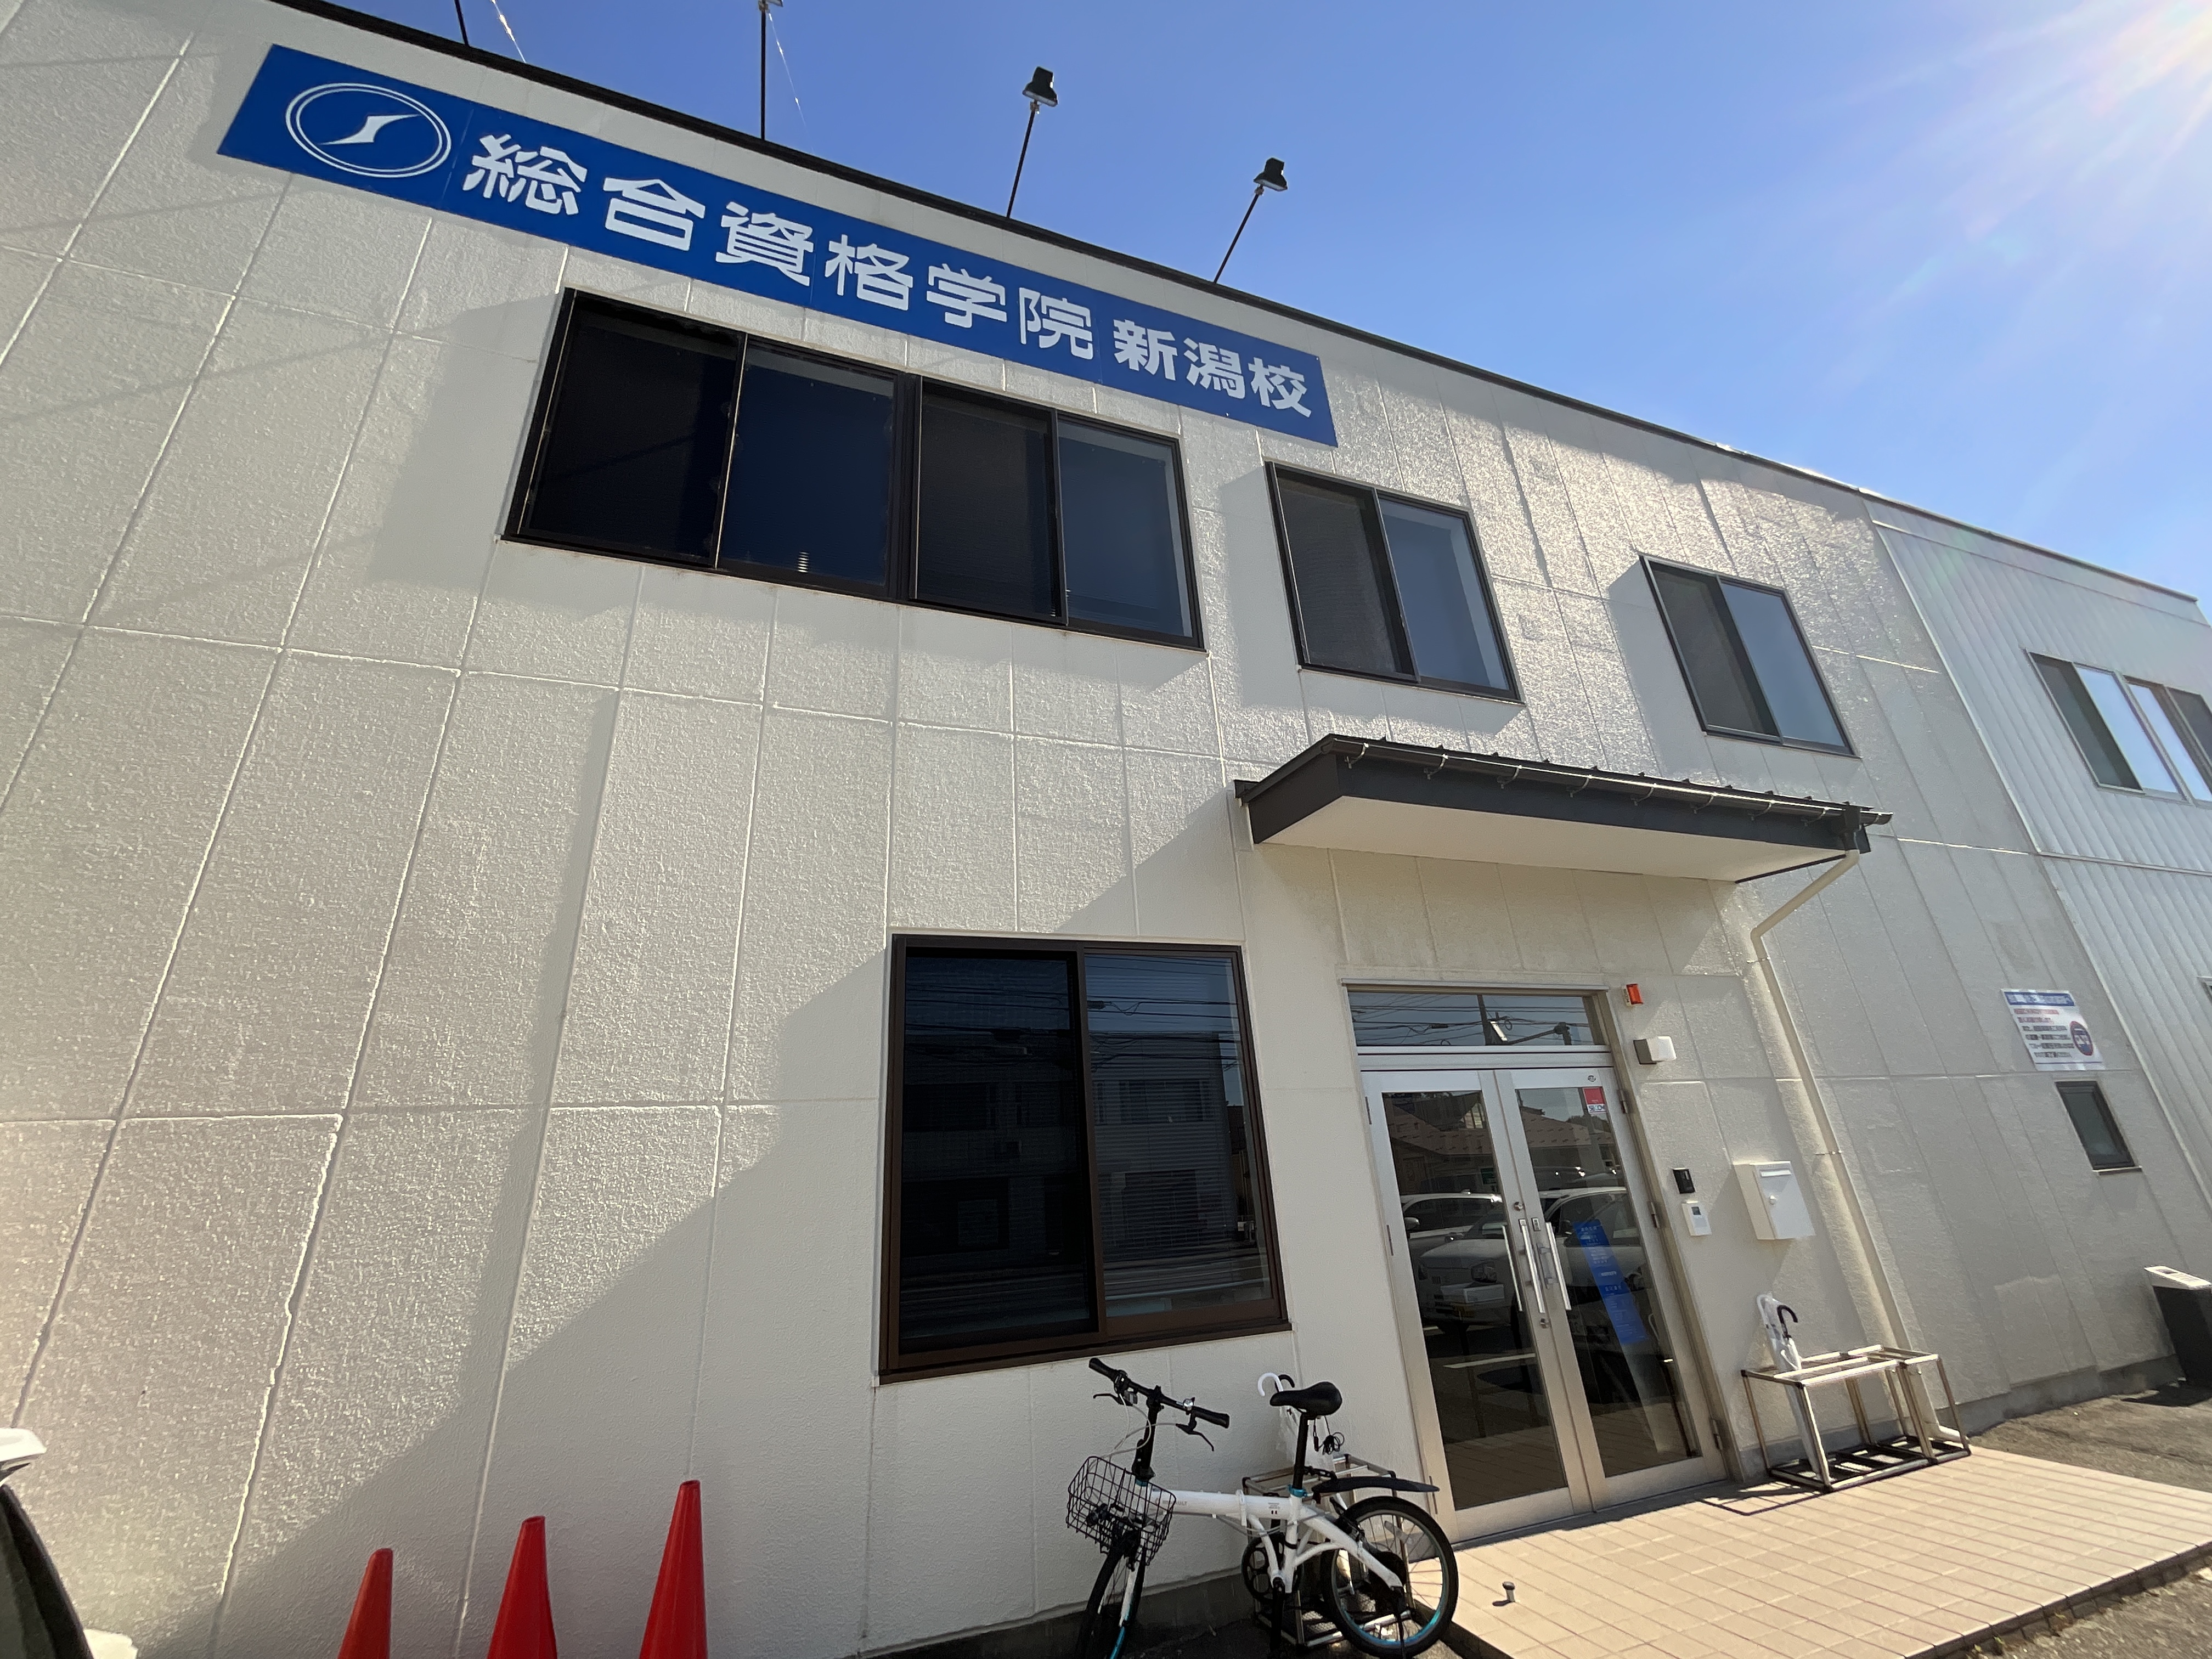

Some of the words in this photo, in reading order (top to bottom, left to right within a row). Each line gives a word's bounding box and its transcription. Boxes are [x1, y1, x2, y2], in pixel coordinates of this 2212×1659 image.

[462, 134, 1094, 360] 総合資格学院
[1113, 318, 1312, 418] 新潟校
